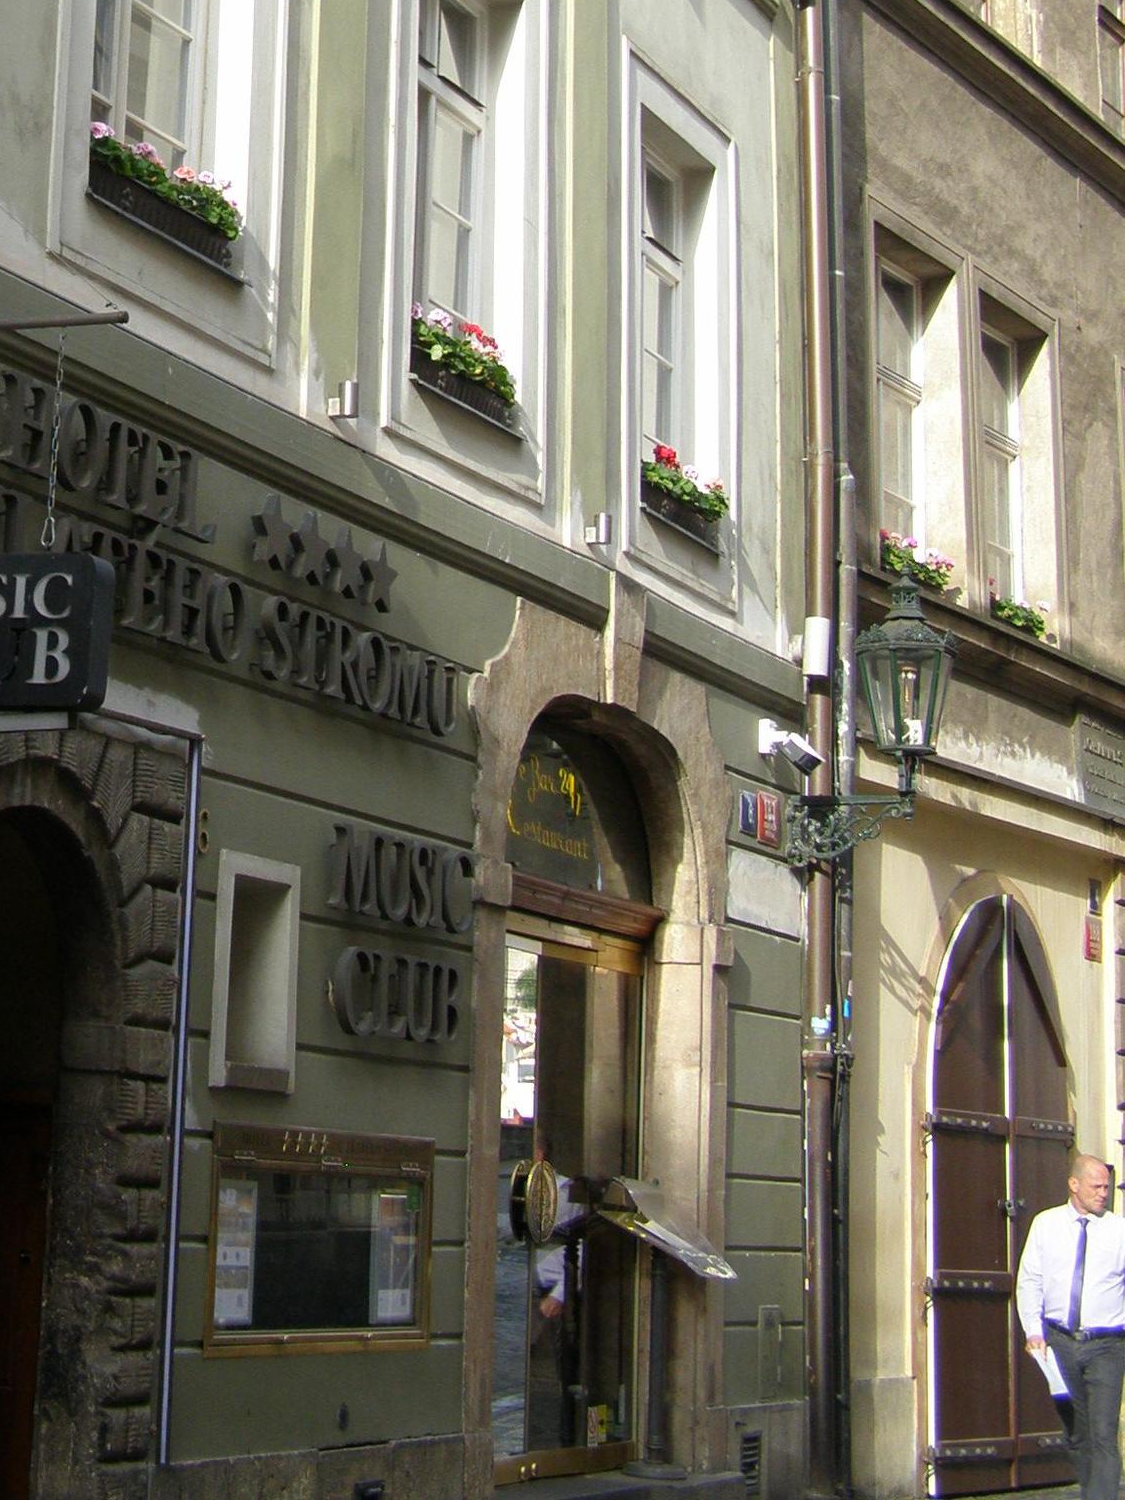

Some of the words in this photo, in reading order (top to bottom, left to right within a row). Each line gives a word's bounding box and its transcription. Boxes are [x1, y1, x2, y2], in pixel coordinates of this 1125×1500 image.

[251, 596, 461, 736] STROMU
[327, 823, 475, 934] MUSIC
[335, 947, 462, 1044] CLUB
